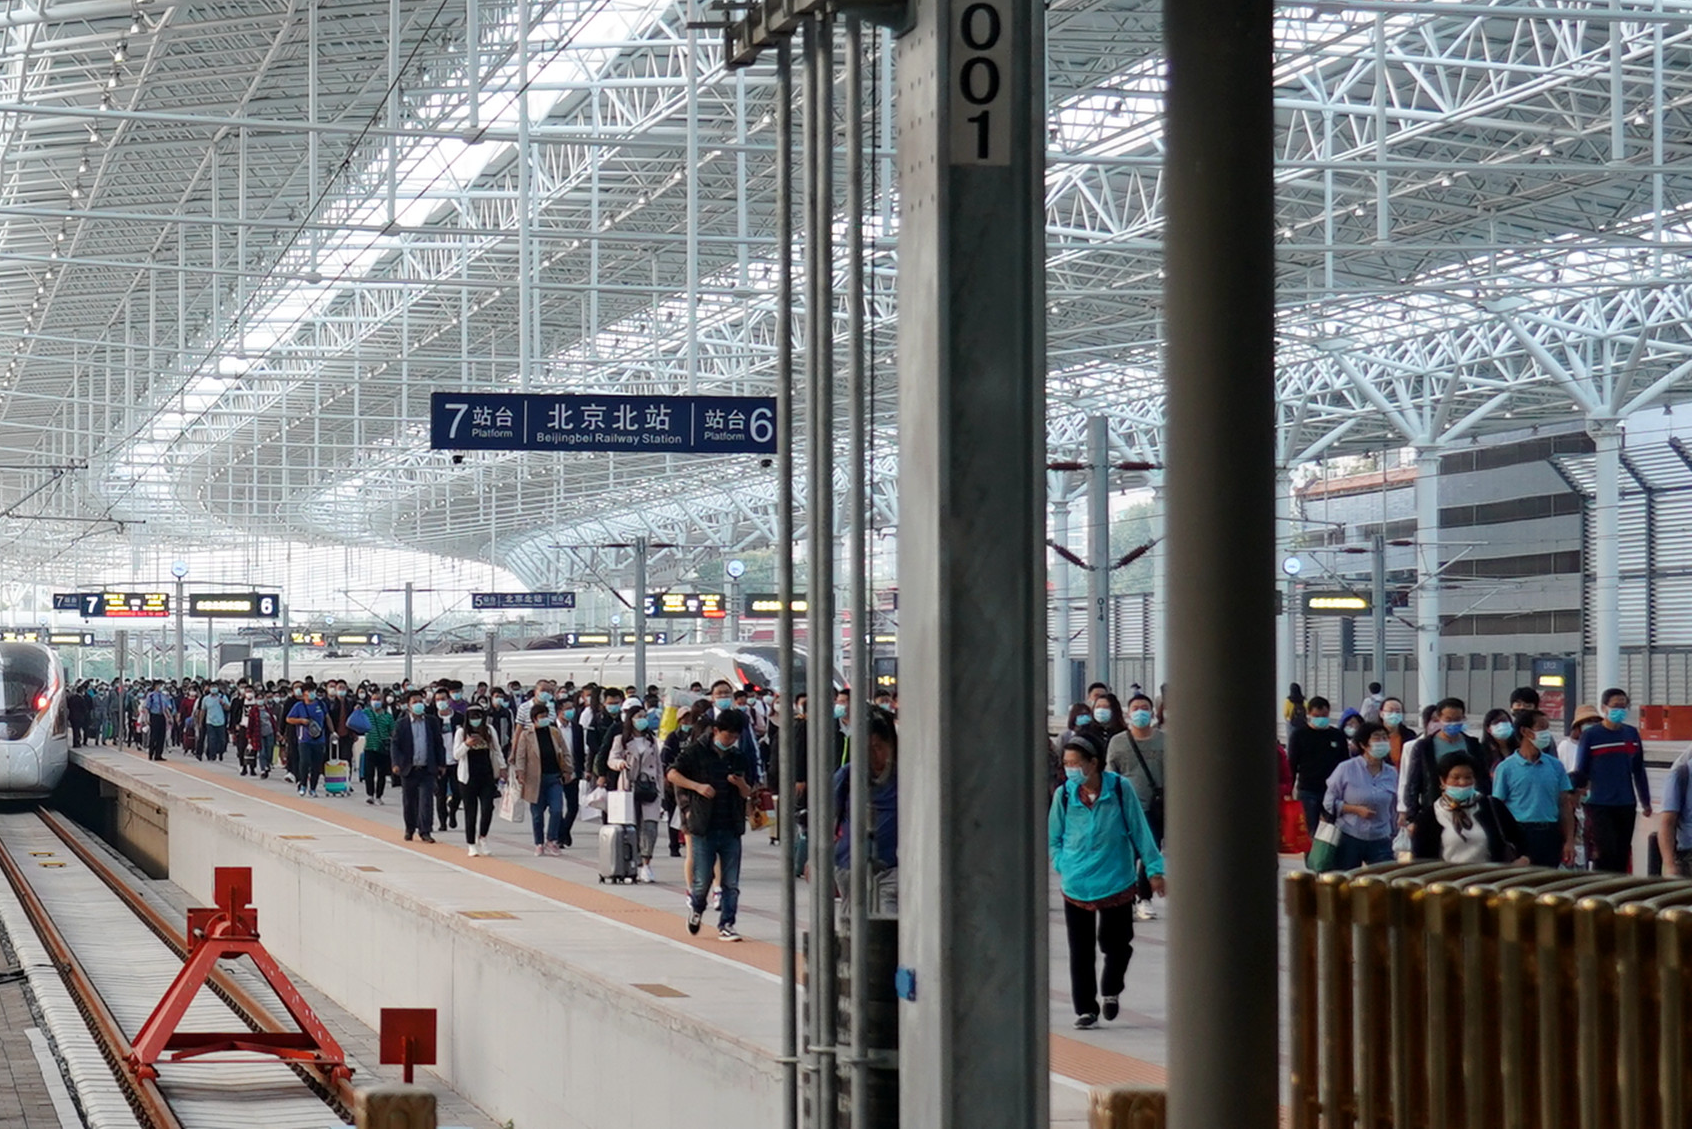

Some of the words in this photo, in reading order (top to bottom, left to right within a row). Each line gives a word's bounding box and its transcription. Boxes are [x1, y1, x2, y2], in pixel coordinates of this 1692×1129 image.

[960, 2, 1001, 160] 001
[444, 403, 469, 439] 7
[472, 405, 514, 427] 站台
[547, 403, 672, 431] 北京北站
[705, 408, 746, 430] 站台
[749, 407, 773, 443] 6
[472, 428, 513, 438] Platform
[536, 432, 593, 445] Beijingbei
[595, 433, 640, 446] Railway
[642, 433, 682, 444] Station
[704, 431, 745, 441] Platform
[55, 595, 64, 607] 7
[86, 596, 98, 613] 7
[260, 597, 273, 614] 6
